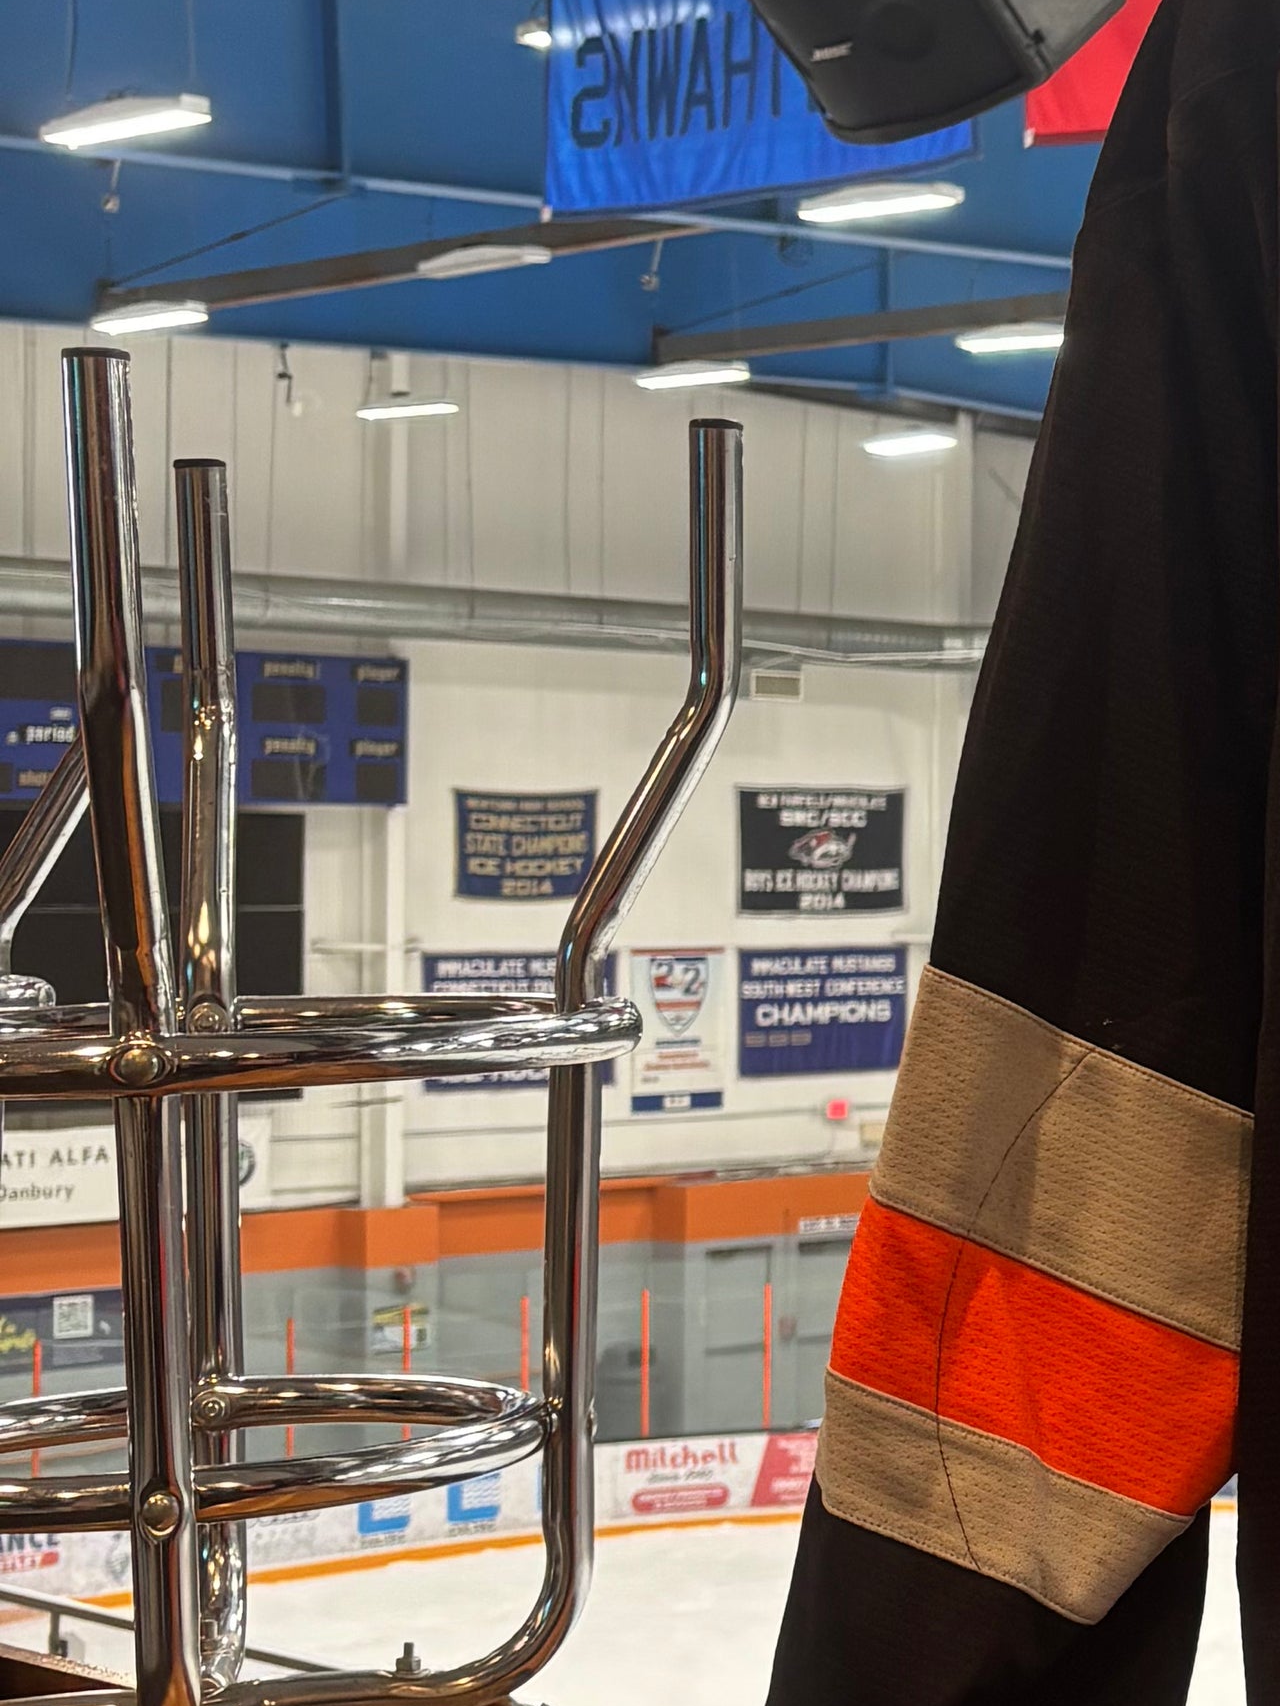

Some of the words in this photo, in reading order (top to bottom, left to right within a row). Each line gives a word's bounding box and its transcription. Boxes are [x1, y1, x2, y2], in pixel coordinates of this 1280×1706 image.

[755, 999, 892, 1027] CHAMPIONS
[49, 1146, 110, 1167] ALFA
[624, 1441, 739, 1472] Mitchell
